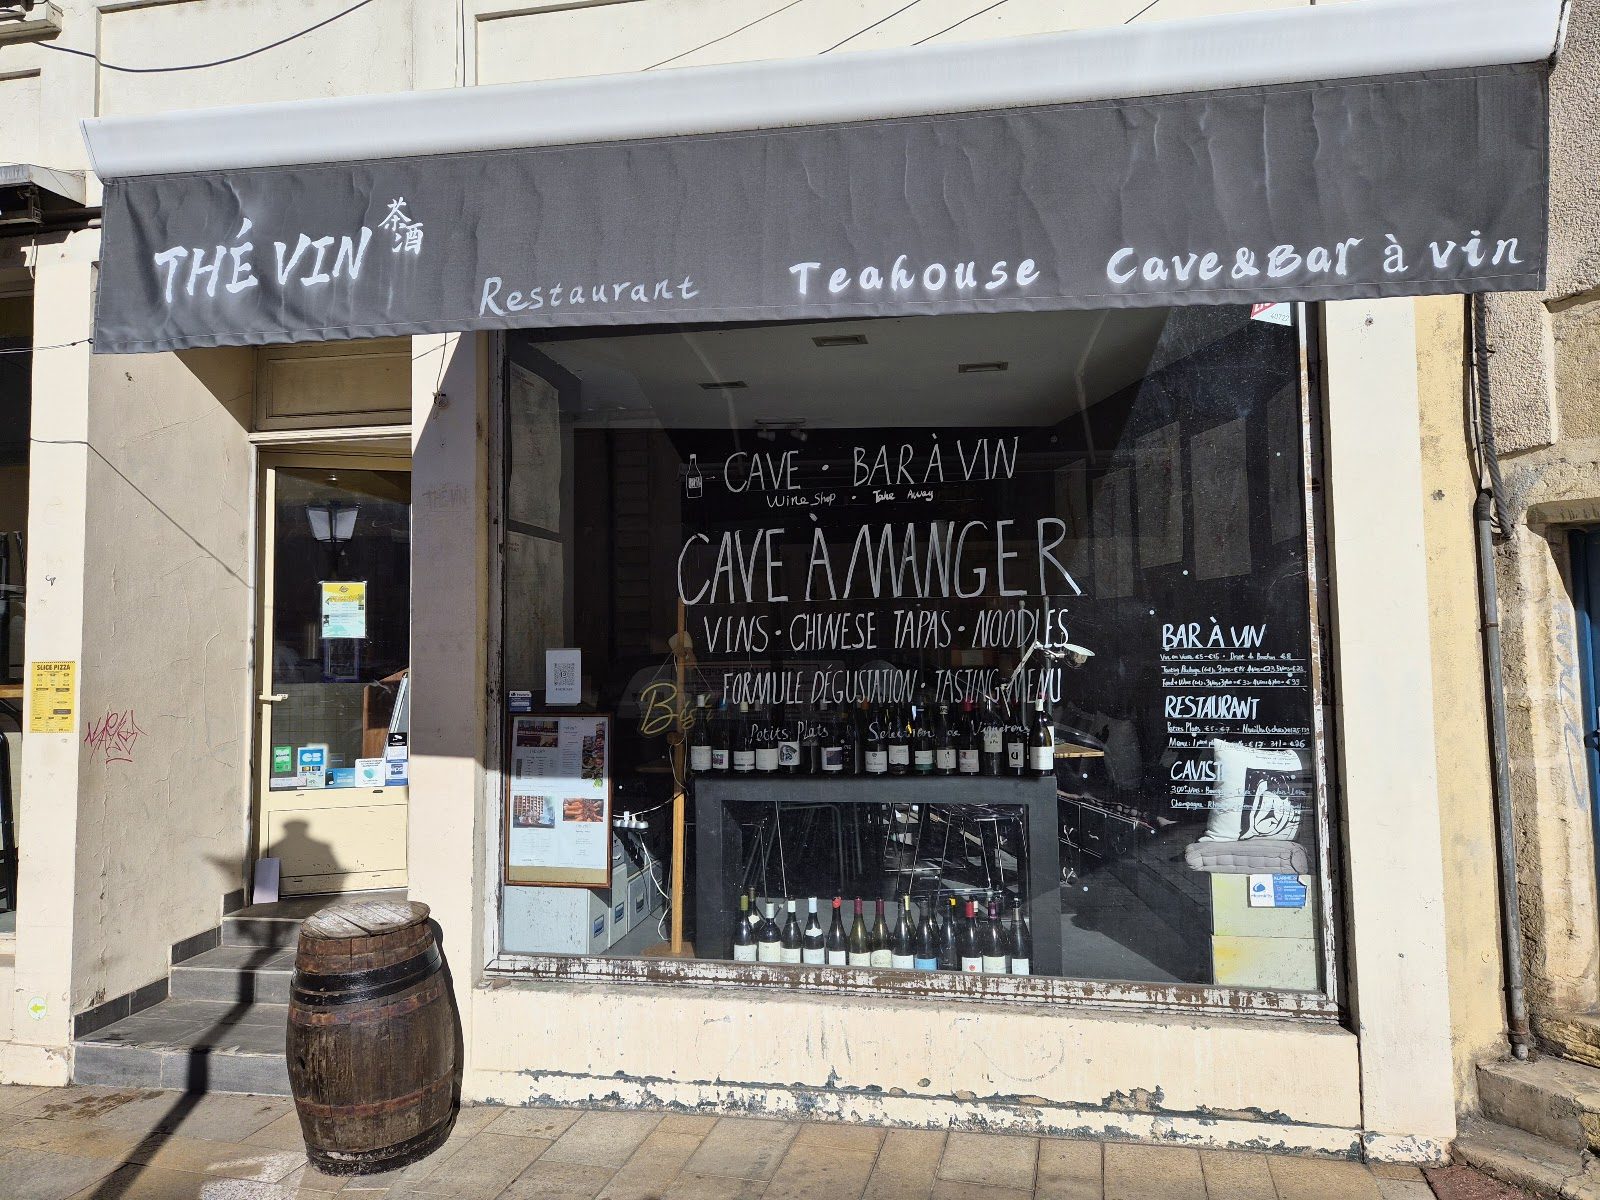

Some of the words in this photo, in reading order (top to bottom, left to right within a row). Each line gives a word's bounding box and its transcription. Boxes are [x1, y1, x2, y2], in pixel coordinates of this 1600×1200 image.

[378, 196, 424, 255] 茶酒
[154, 218, 258, 303] THÉ
[274, 226, 372, 286] VIN
[1383, 233, 1409, 273] à
[1429, 230, 1524, 269] vin
[789, 254, 1040, 295] Teahouse
[479, 275, 699, 317] Restaurant
[723, 450, 801, 493] CAVE
[853, 444, 915, 487] BAR
[923, 432, 944, 483] À
[956, 436, 1020, 481] VIN
[766, 494, 810, 508] Wine
[810, 492, 836, 506] Shop
[677, 527, 789, 606] CAVE
[804, 512, 837, 601] À
[842, 517, 1082, 599] MANGER
[703, 615, 769, 653] VINS
[789, 611, 877, 651] CHINESE
[893, 609, 951, 649] TAPAS
[971, 608, 1069, 648] NOODLES
[1162, 622, 1203, 649] BAR
[1206, 616, 1226, 648] À
[1230, 623, 1267, 648] VIN
[723, 670, 804, 705] FORMULE
[811, 664, 918, 705] DÉGUSTATION
[935, 668, 1000, 704] TASTING
[1004, 668, 1062, 704] MENU
[1165, 694, 1261, 719] RESTAURANT
[749, 723, 789, 745] Petits
